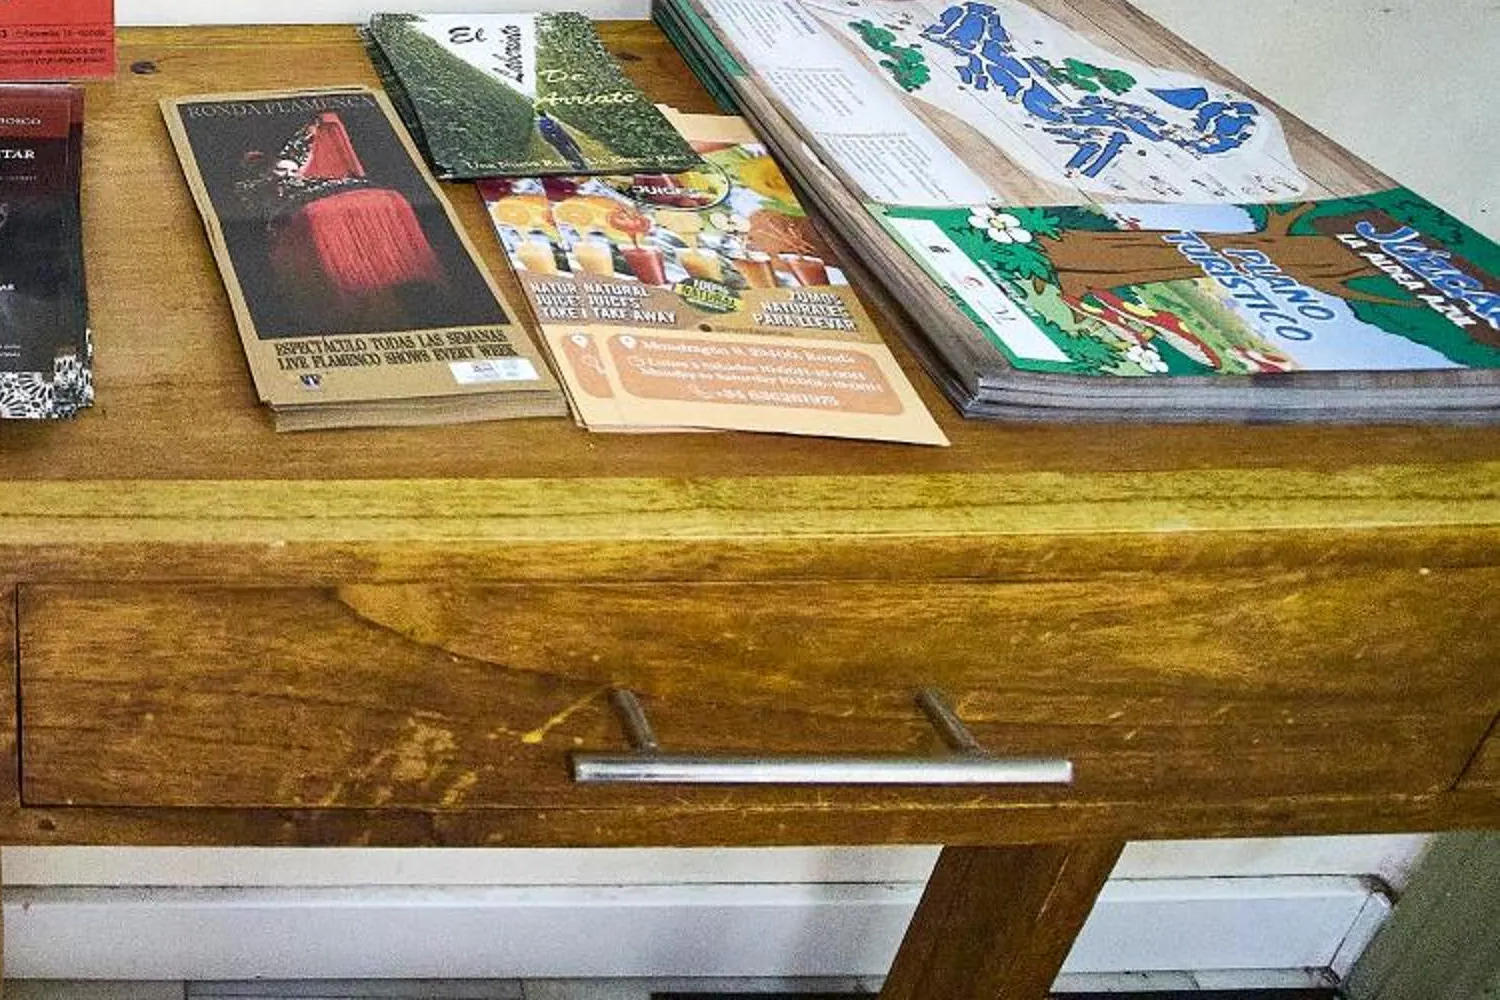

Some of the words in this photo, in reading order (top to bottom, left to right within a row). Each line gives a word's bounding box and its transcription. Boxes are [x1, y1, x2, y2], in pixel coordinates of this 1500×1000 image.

[448, 26, 487, 44] El
[188, 103, 261, 118] RONDA
[531, 283, 577, 294] NATUR
[1222, 248, 1336, 321] PLANO
[1335, 233, 1367, 249] LA
[1359, 251, 1426, 292] ALDEA
[1417, 294, 1479, 329] AZUL
[584, 283, 651, 297] NATURAL
[536, 295, 579, 305] JUICE
[588, 295, 641, 308] JUICES
[542, 307, 577, 319] TAKE
[594, 308, 626, 320] TAKE
[633, 310, 677, 323] AWAY
[753, 312, 796, 327] PARA
[796, 315, 856, 330] LLEVAR
[370, 336, 415, 350] TODAS
[416, 334, 444, 348] LAS
[445, 329, 509, 346] SEMANAS
[277, 356, 310, 371] LIVE
[311, 353, 381, 369] FLAMENCO
[385, 350, 430, 365] SHOWS
[434, 346, 476, 361] EVERY
[481, 343, 519, 357] WEEK
